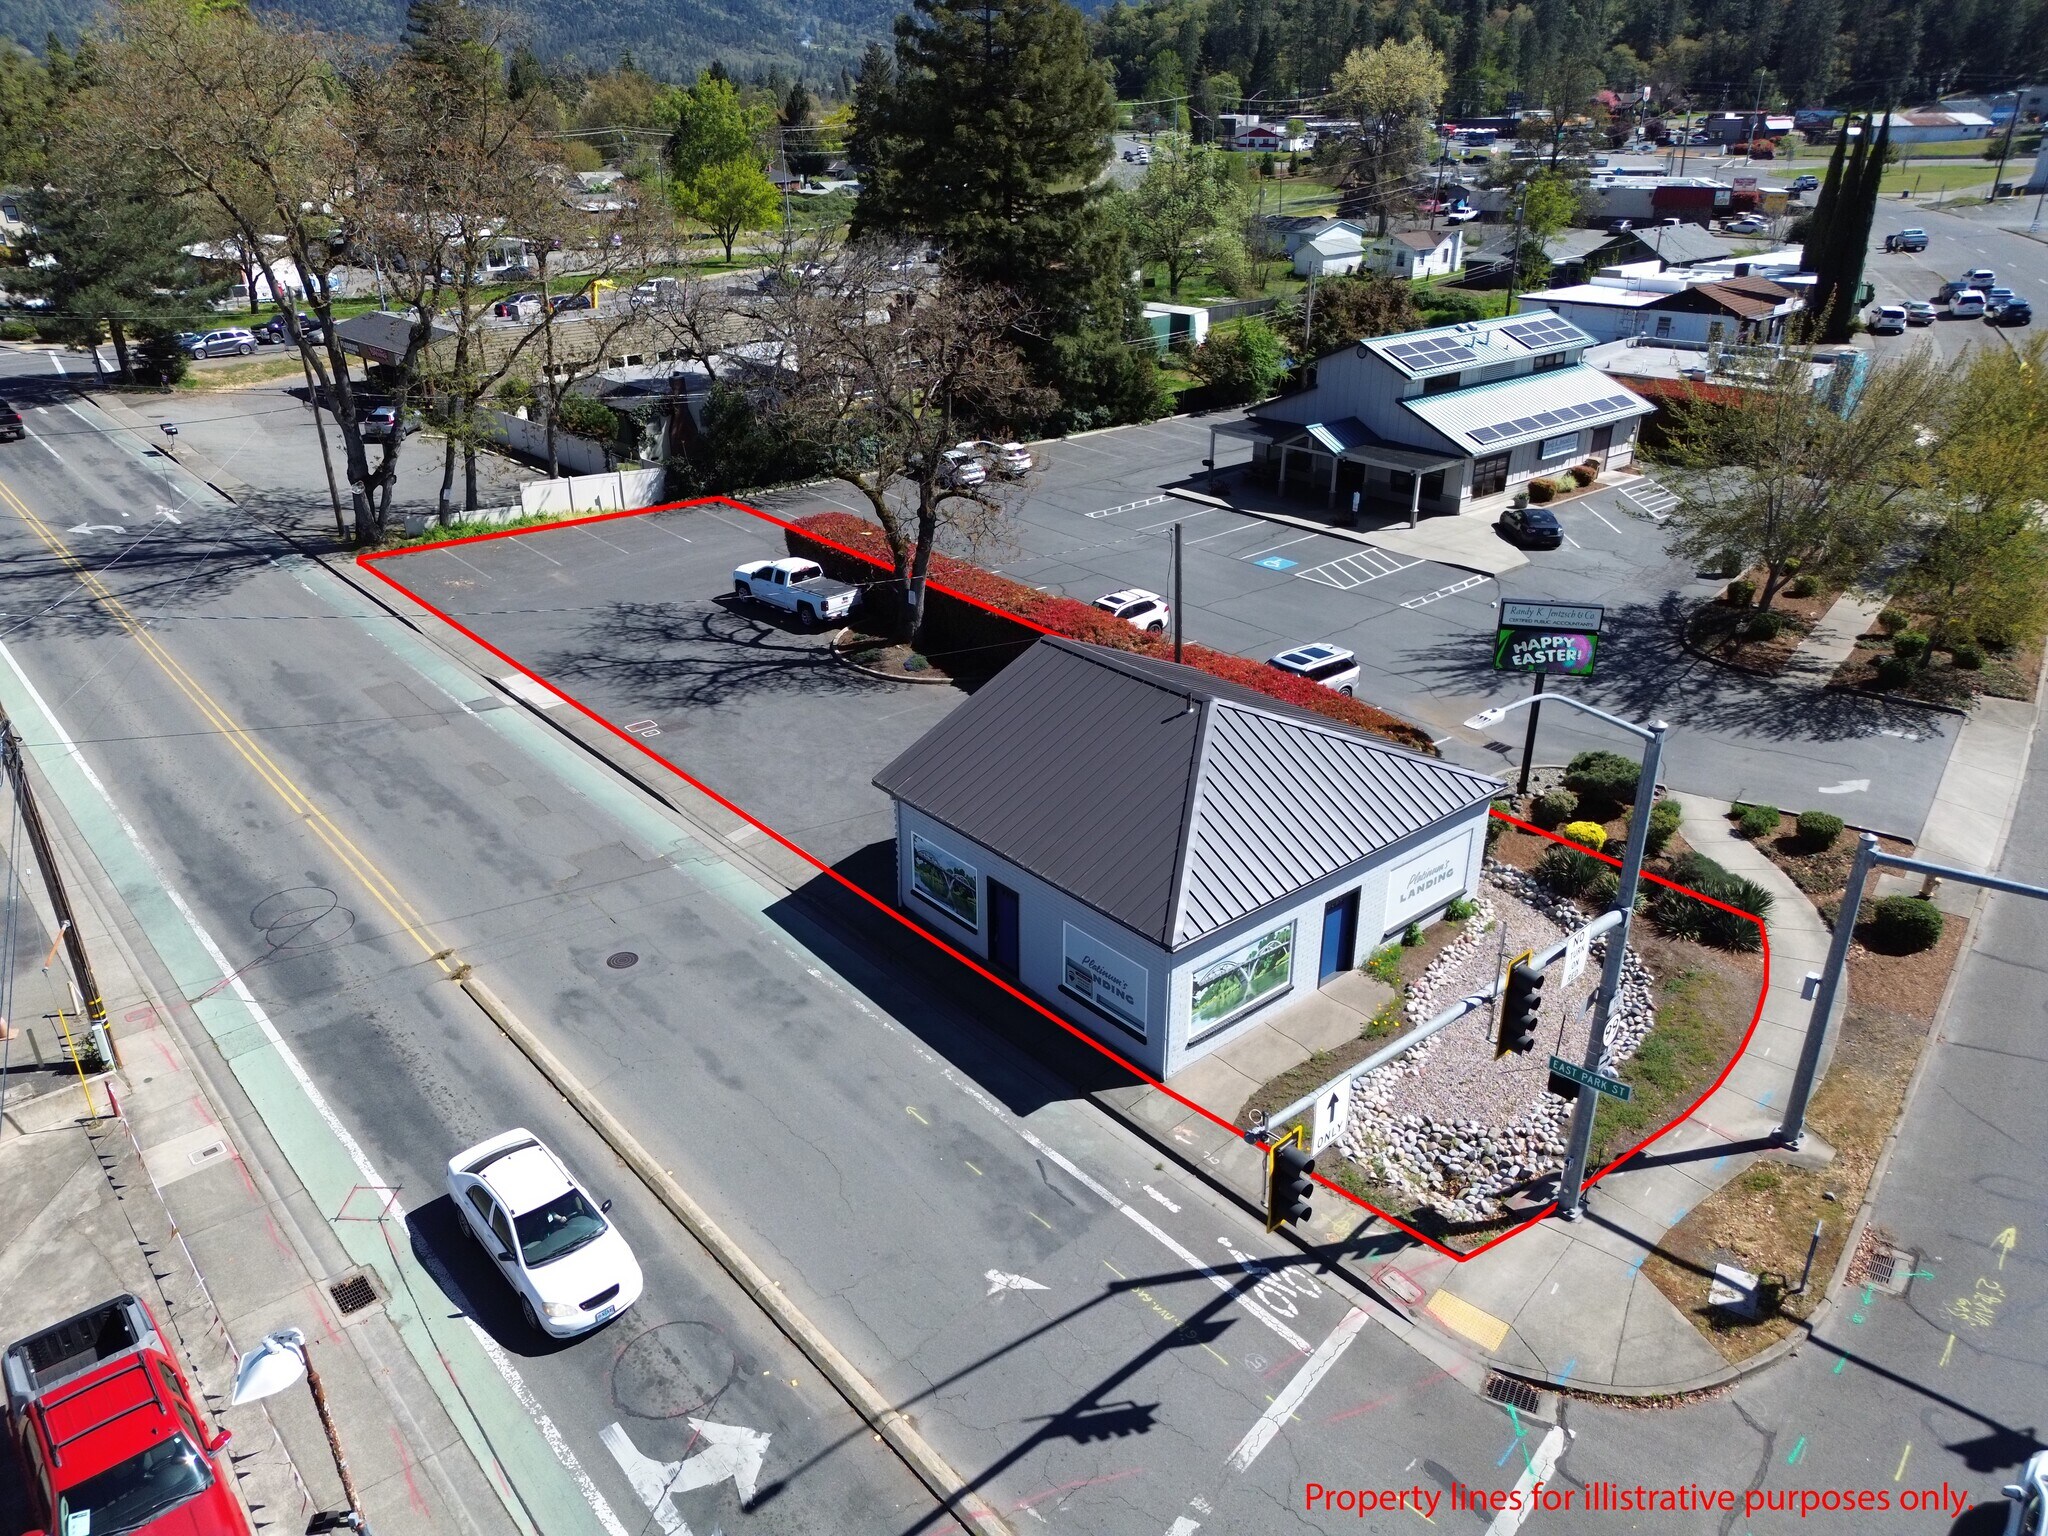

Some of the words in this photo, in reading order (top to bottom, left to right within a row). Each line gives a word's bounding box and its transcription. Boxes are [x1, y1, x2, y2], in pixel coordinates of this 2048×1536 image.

[1510, 606, 1534, 618] Randy
[1513, 636, 1575, 654] HAPPY
[1511, 649, 1582, 666] EASTER!
[1406, 859, 1450, 889] Platinum's
[1400, 868, 1454, 903] LANDING
[1573, 931, 1586, 946] NO
[1570, 945, 1585, 959] TURN
[1081, 955, 1129, 989] Platinum's
[1568, 969, 1579, 981] RED
[1571, 960, 1580, 970] ON
[1092, 973, 1135, 1006] NDING
[1605, 1018, 1619, 1040] 99
[1552, 1060, 1578, 1077] EAST
[1581, 1073, 1607, 1090] PARK
[1611, 1084, 1626, 1096] ST
[1317, 1120, 1343, 1149] ONLY
